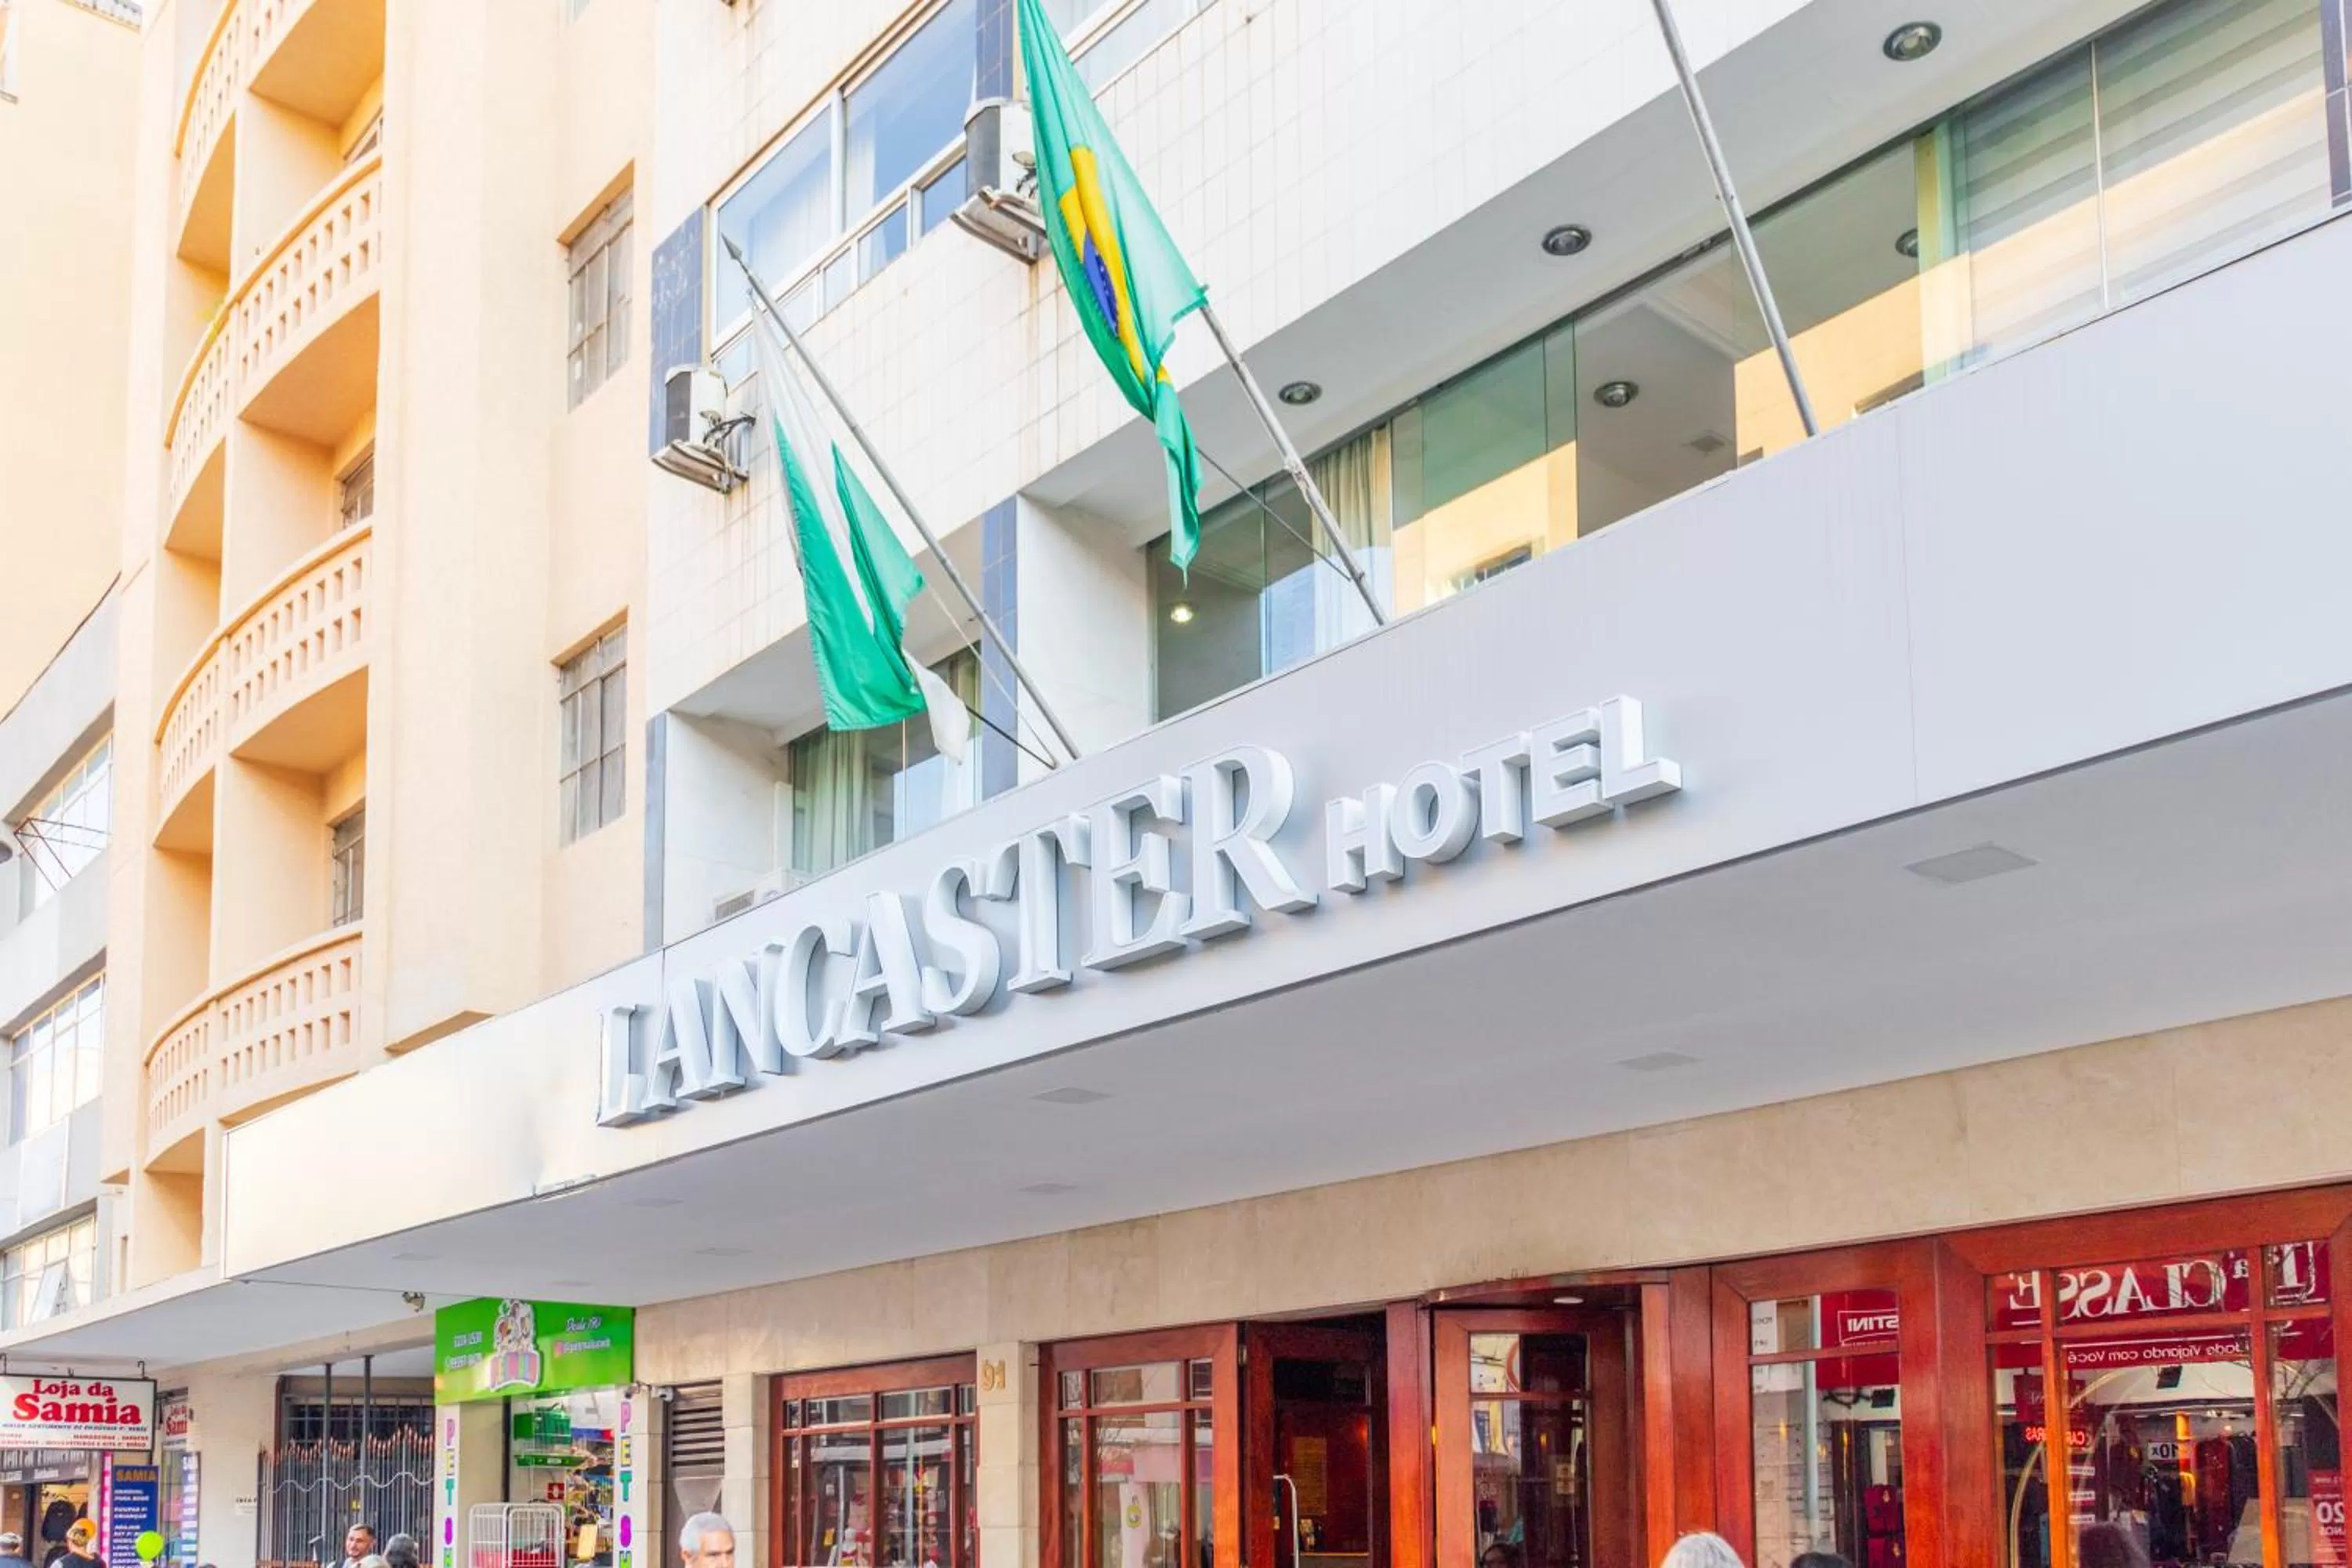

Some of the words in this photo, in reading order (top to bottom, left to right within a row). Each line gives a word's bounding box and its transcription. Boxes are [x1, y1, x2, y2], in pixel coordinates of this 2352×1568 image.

[598, 744, 1319, 1127] LANCASTER
[1326, 695, 1682, 893] HOTEL
[33, 1379, 81, 1399] Loja
[87, 1381, 114, 1396] da
[982, 1359, 1006, 1392] 91
[13, 1392, 142, 1425] Samia
[445, 1418, 456, 1506] PET
[619, 1401, 633, 1502] PET
[115, 1469, 157, 1482] SAMIA
